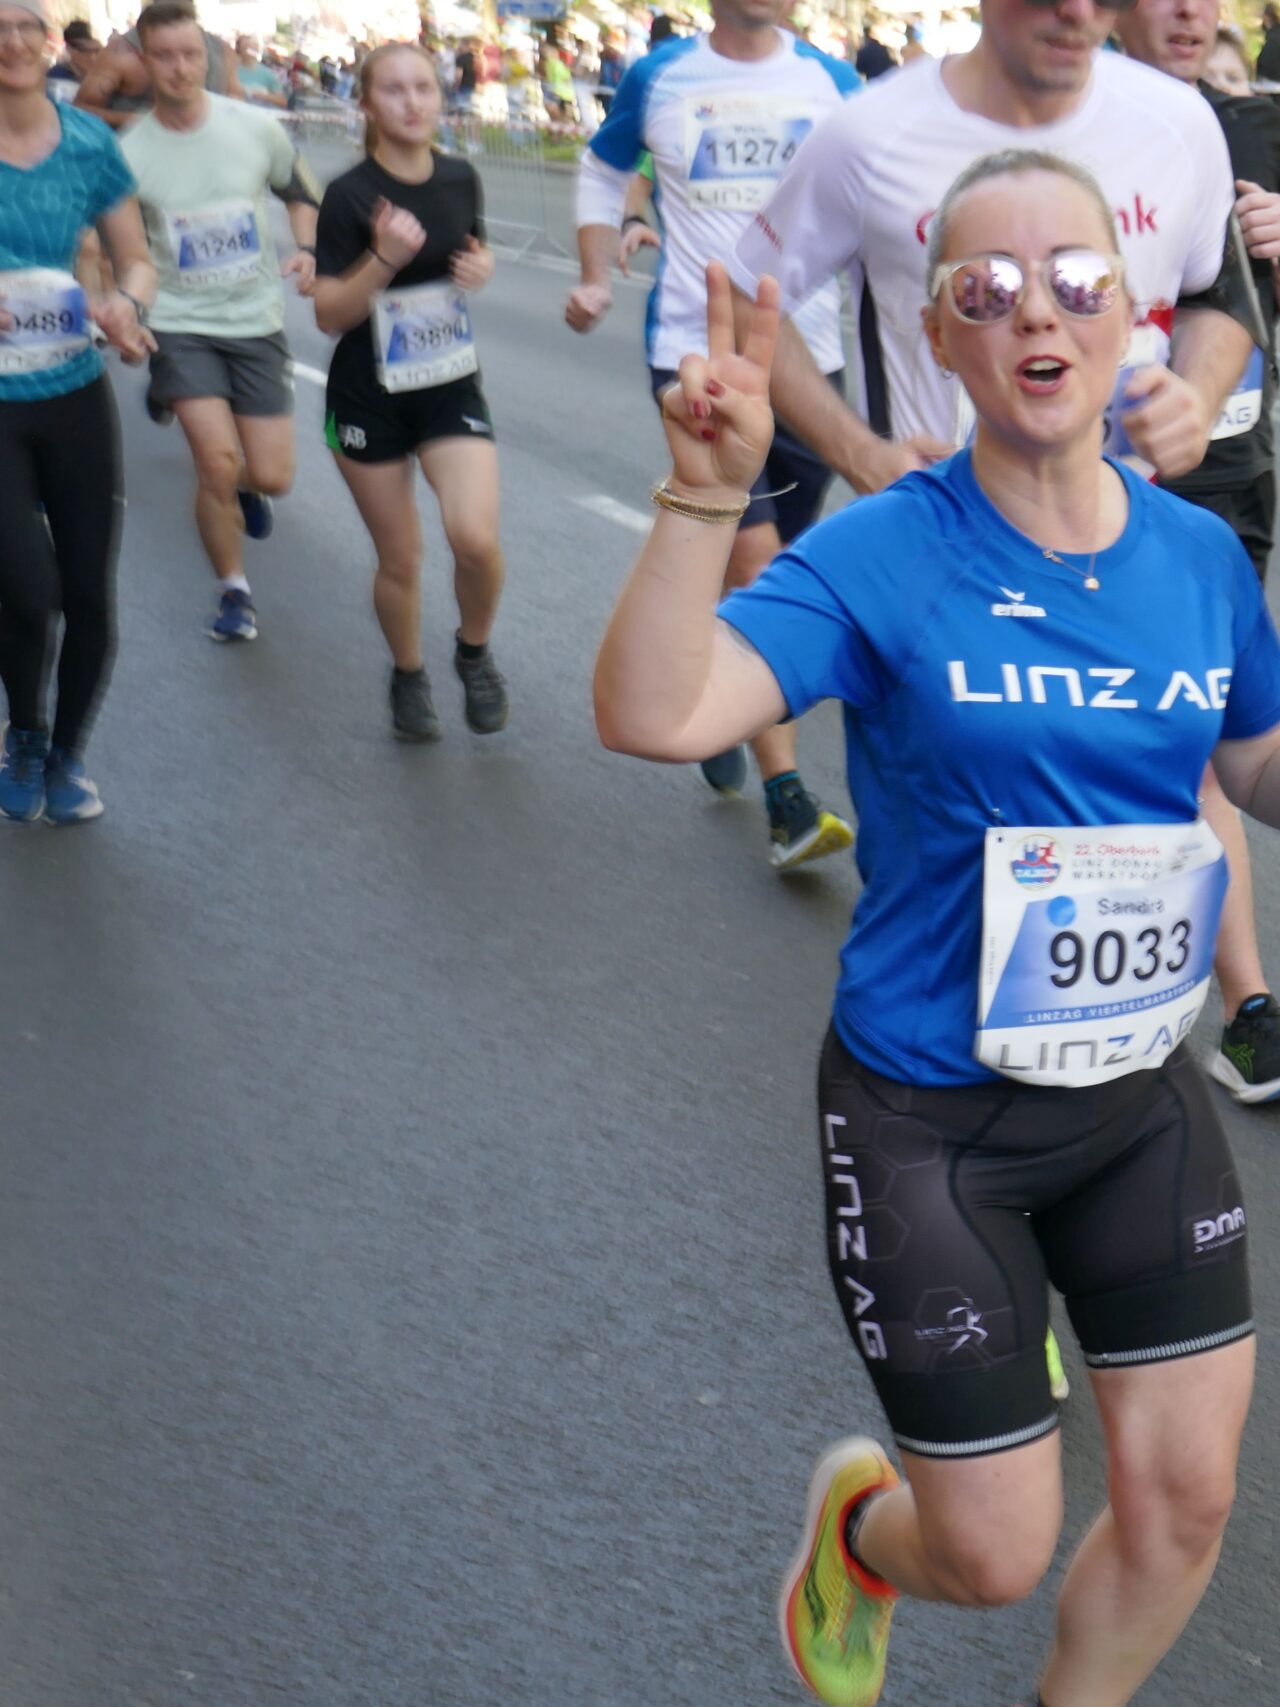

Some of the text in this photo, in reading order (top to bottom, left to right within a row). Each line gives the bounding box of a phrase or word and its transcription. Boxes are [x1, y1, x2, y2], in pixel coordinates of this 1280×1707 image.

[705, 138, 795, 166] 11274
[948, 660, 1139, 709] LINZ
[1050, 918, 1191, 988] 9033
[999, 1033, 1136, 1071] LINZ
